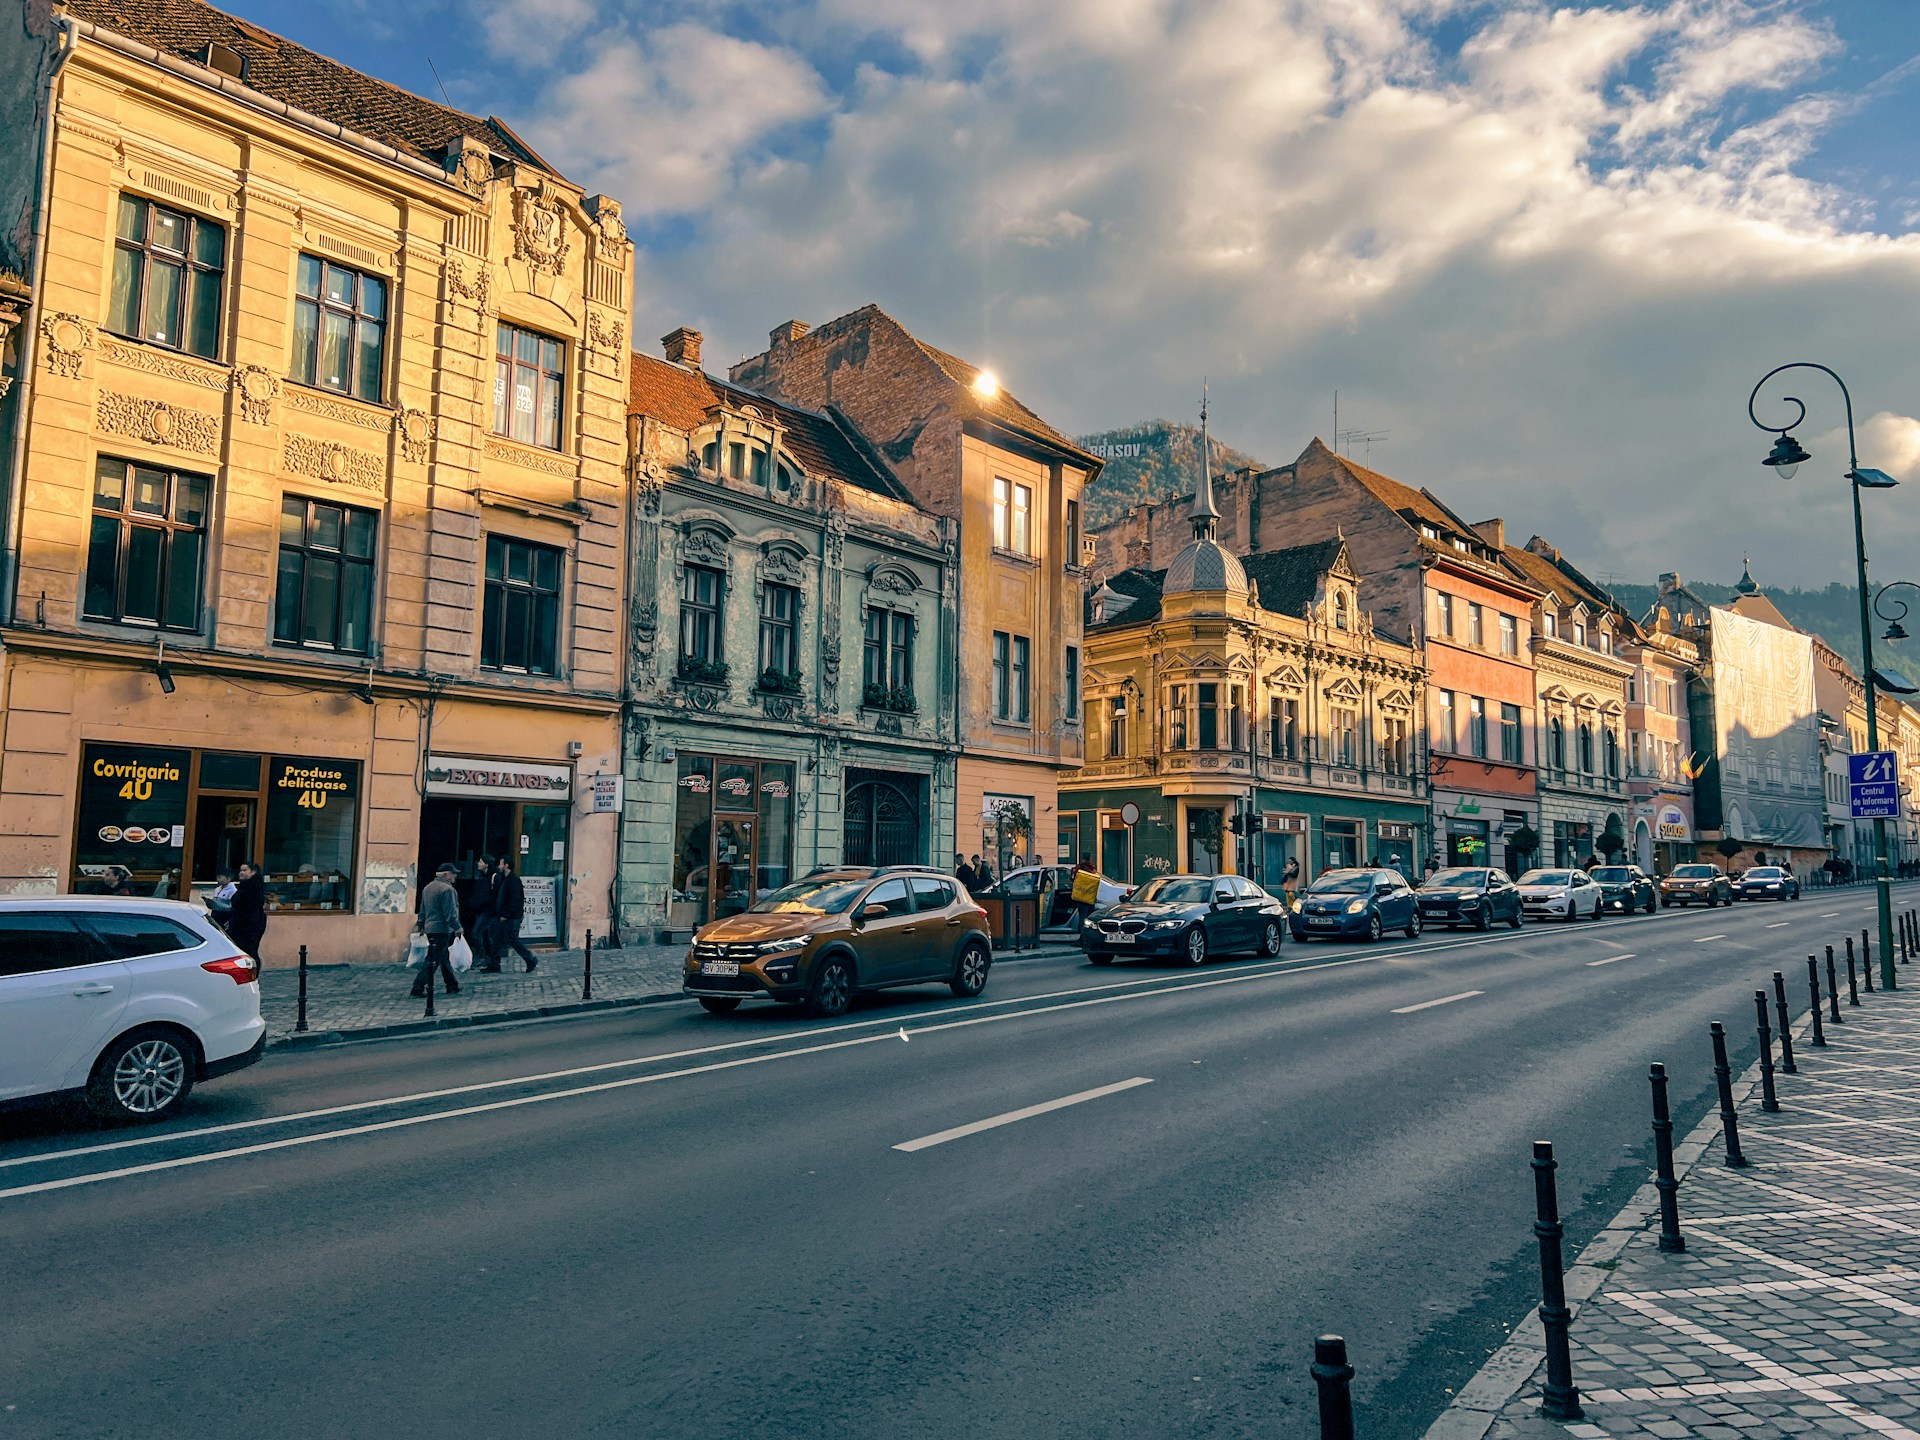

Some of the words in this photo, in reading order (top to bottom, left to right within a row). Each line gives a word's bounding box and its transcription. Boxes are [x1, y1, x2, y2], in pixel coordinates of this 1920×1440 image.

[517, 399, 531, 411] 325
[1090, 444, 1141, 458] BRASOV
[93, 758, 180, 783] Covrigaria
[285, 765, 342, 779] Produse
[277, 776, 348, 791] delicioase
[448, 769, 550, 789] EXCHANGE
[118, 780, 153, 801] 4U
[1861, 786, 1885, 795] Centrul
[297, 790, 327, 809] 4U
[1853, 798, 1861, 806] de
[1863, 797, 1894, 805] Informare
[705, 964, 714, 973] BV
